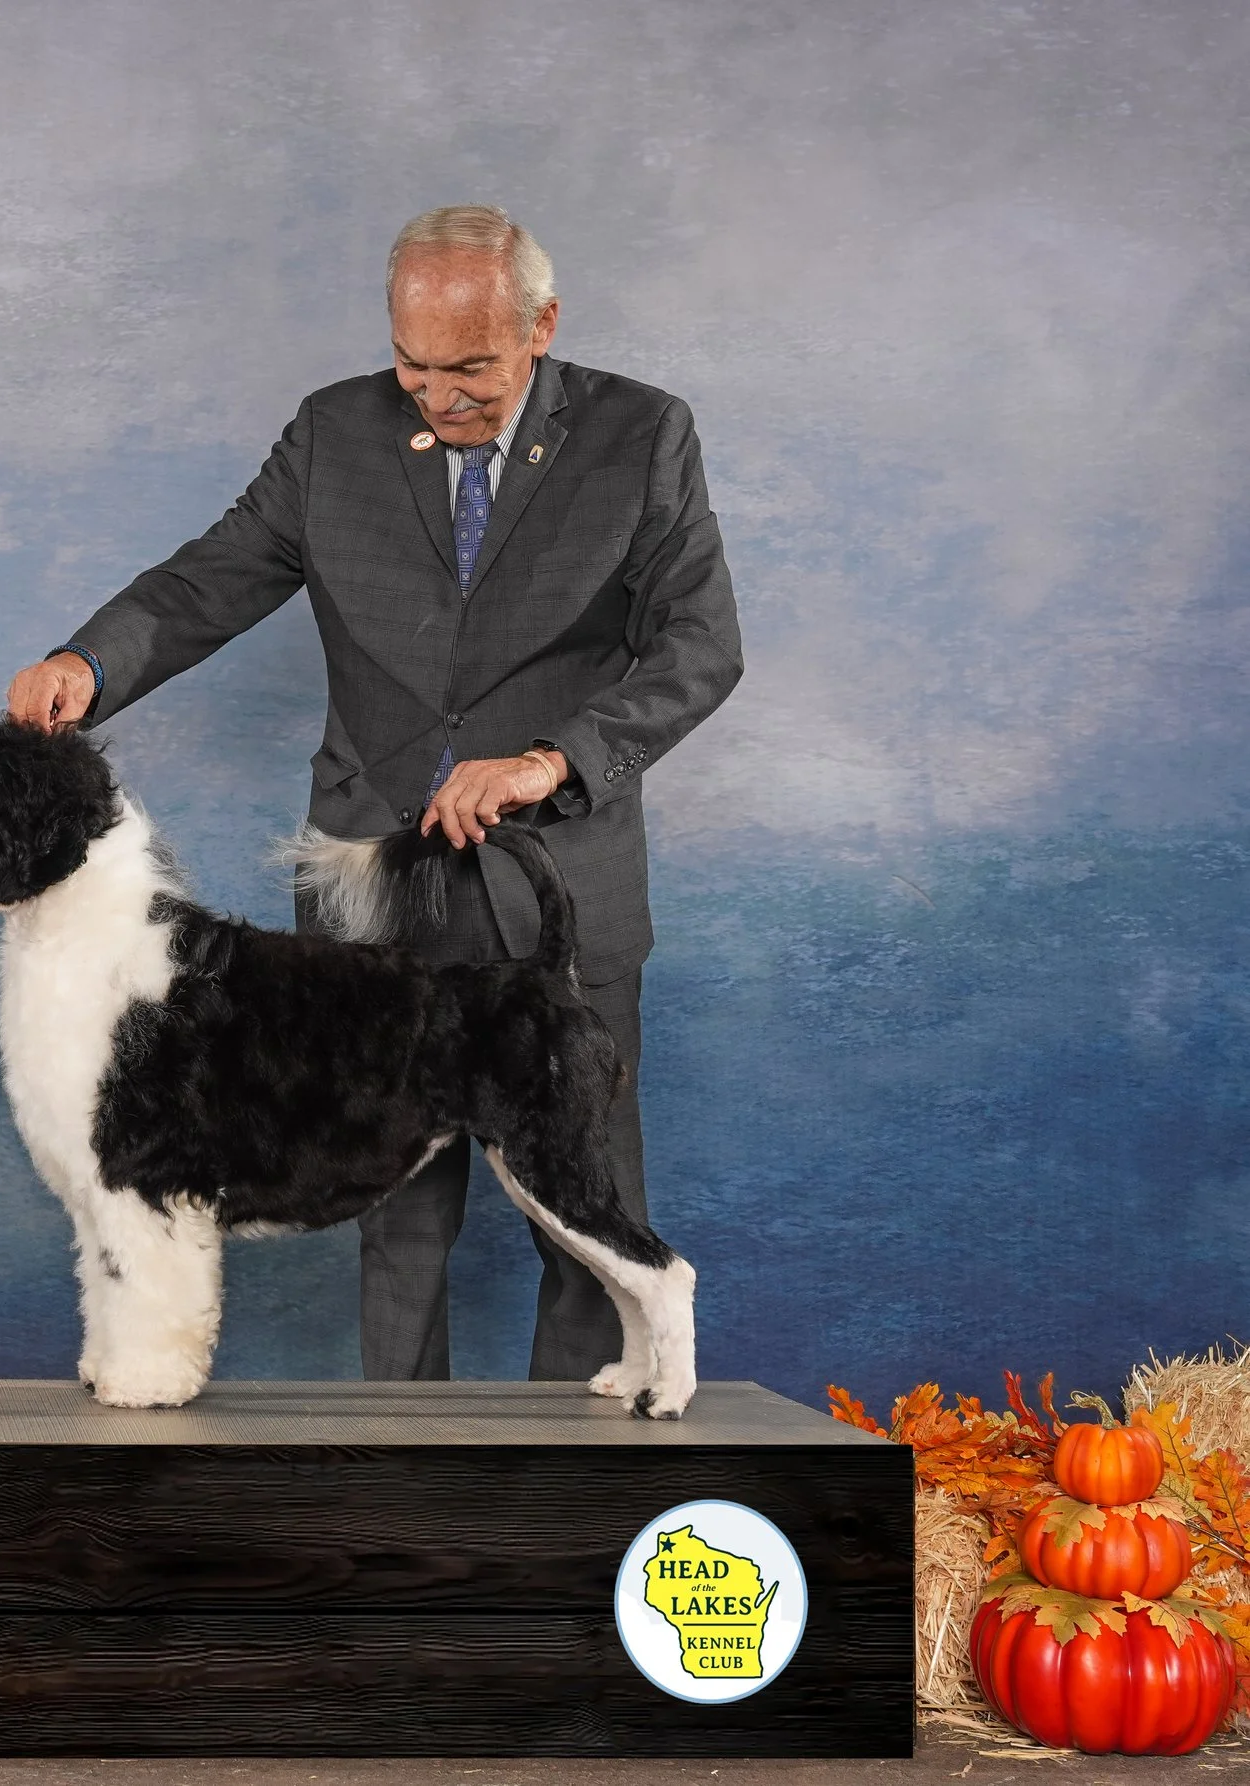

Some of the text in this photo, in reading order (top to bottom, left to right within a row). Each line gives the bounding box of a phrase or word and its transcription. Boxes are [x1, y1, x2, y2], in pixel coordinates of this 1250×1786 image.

[659, 1560, 729, 1579] HEAD
[691, 1584, 716, 1592] of the
[671, 1597, 752, 1616] LAKES
[687, 1637, 755, 1650] KENNEL
[699, 1656, 743, 1669] CLUB
